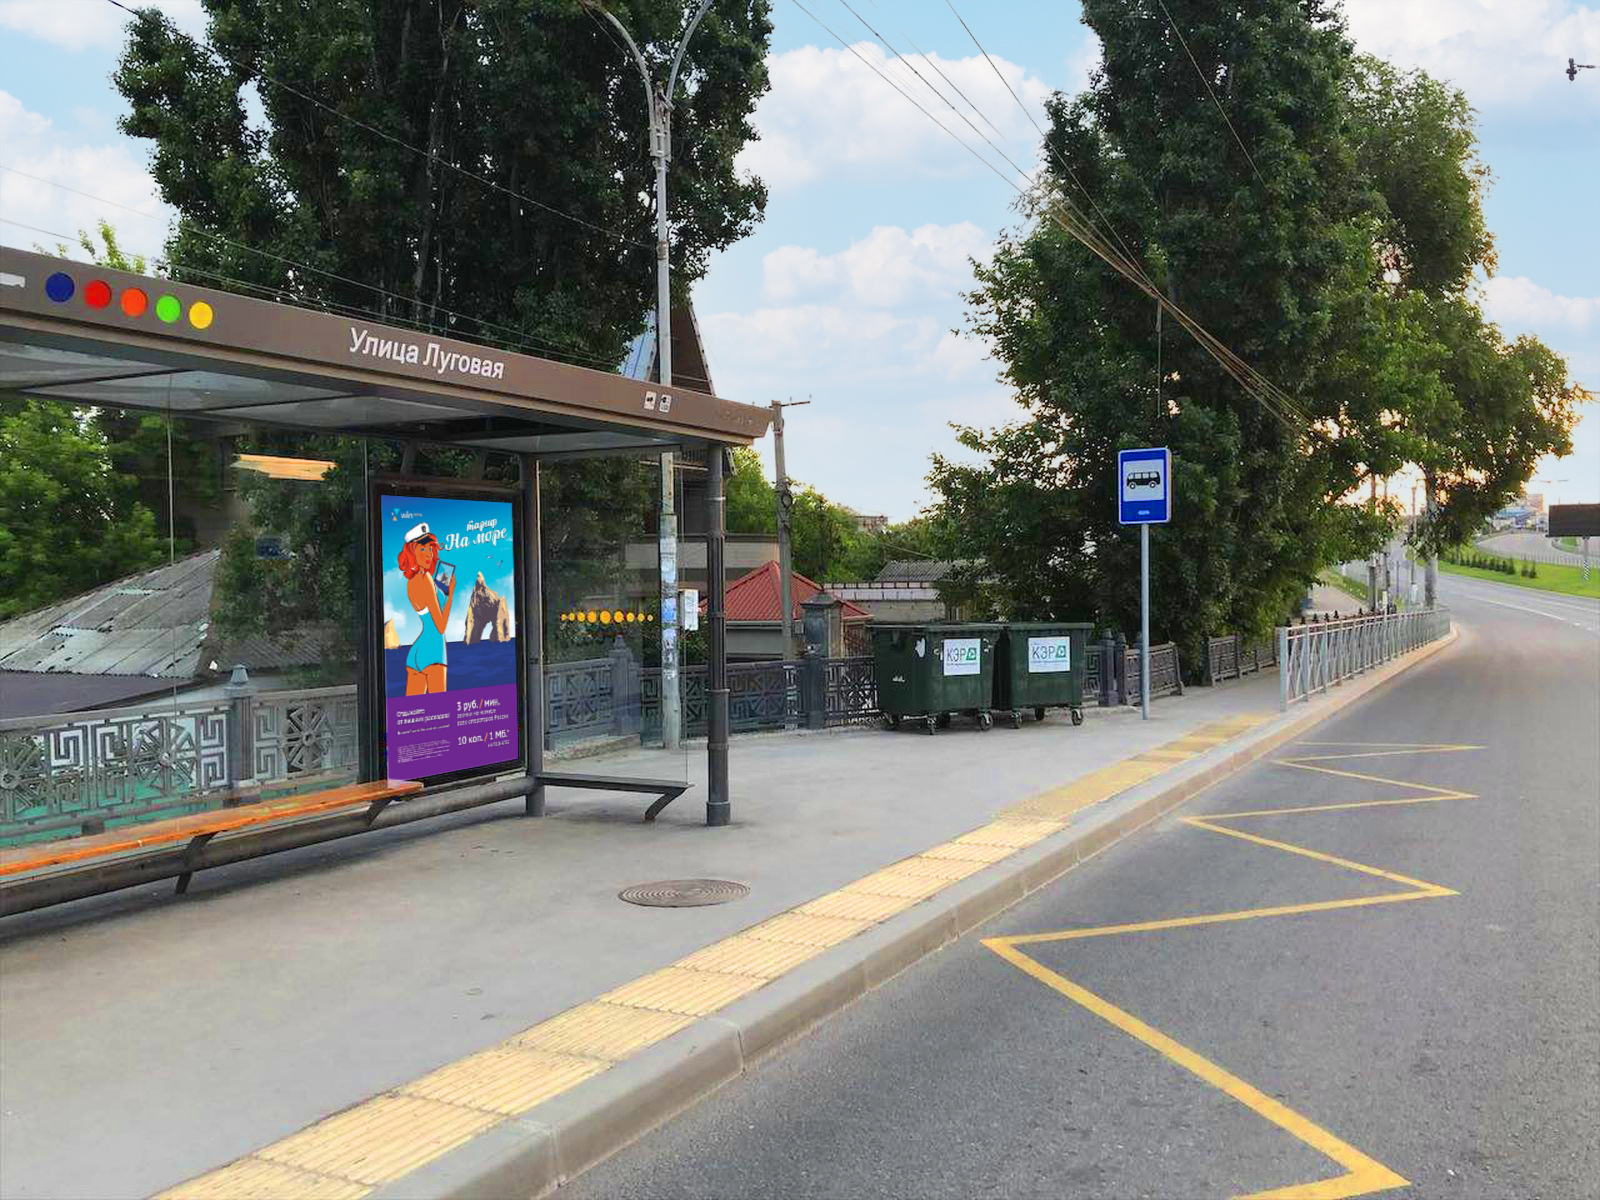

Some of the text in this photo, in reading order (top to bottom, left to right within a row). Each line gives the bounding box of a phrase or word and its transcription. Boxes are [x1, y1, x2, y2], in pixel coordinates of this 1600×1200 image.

[349, 328, 504, 379] Улица Луговая
[466, 518, 497, 532] тариф
[444, 528, 508, 551] На море
[456, 701, 462, 711] 3
[463, 699, 479, 712] руб.
[484, 698, 501, 707] мин.
[457, 736, 467, 745] 10
[468, 735, 483, 744] коп.
[489, 731, 494, 740] 1
